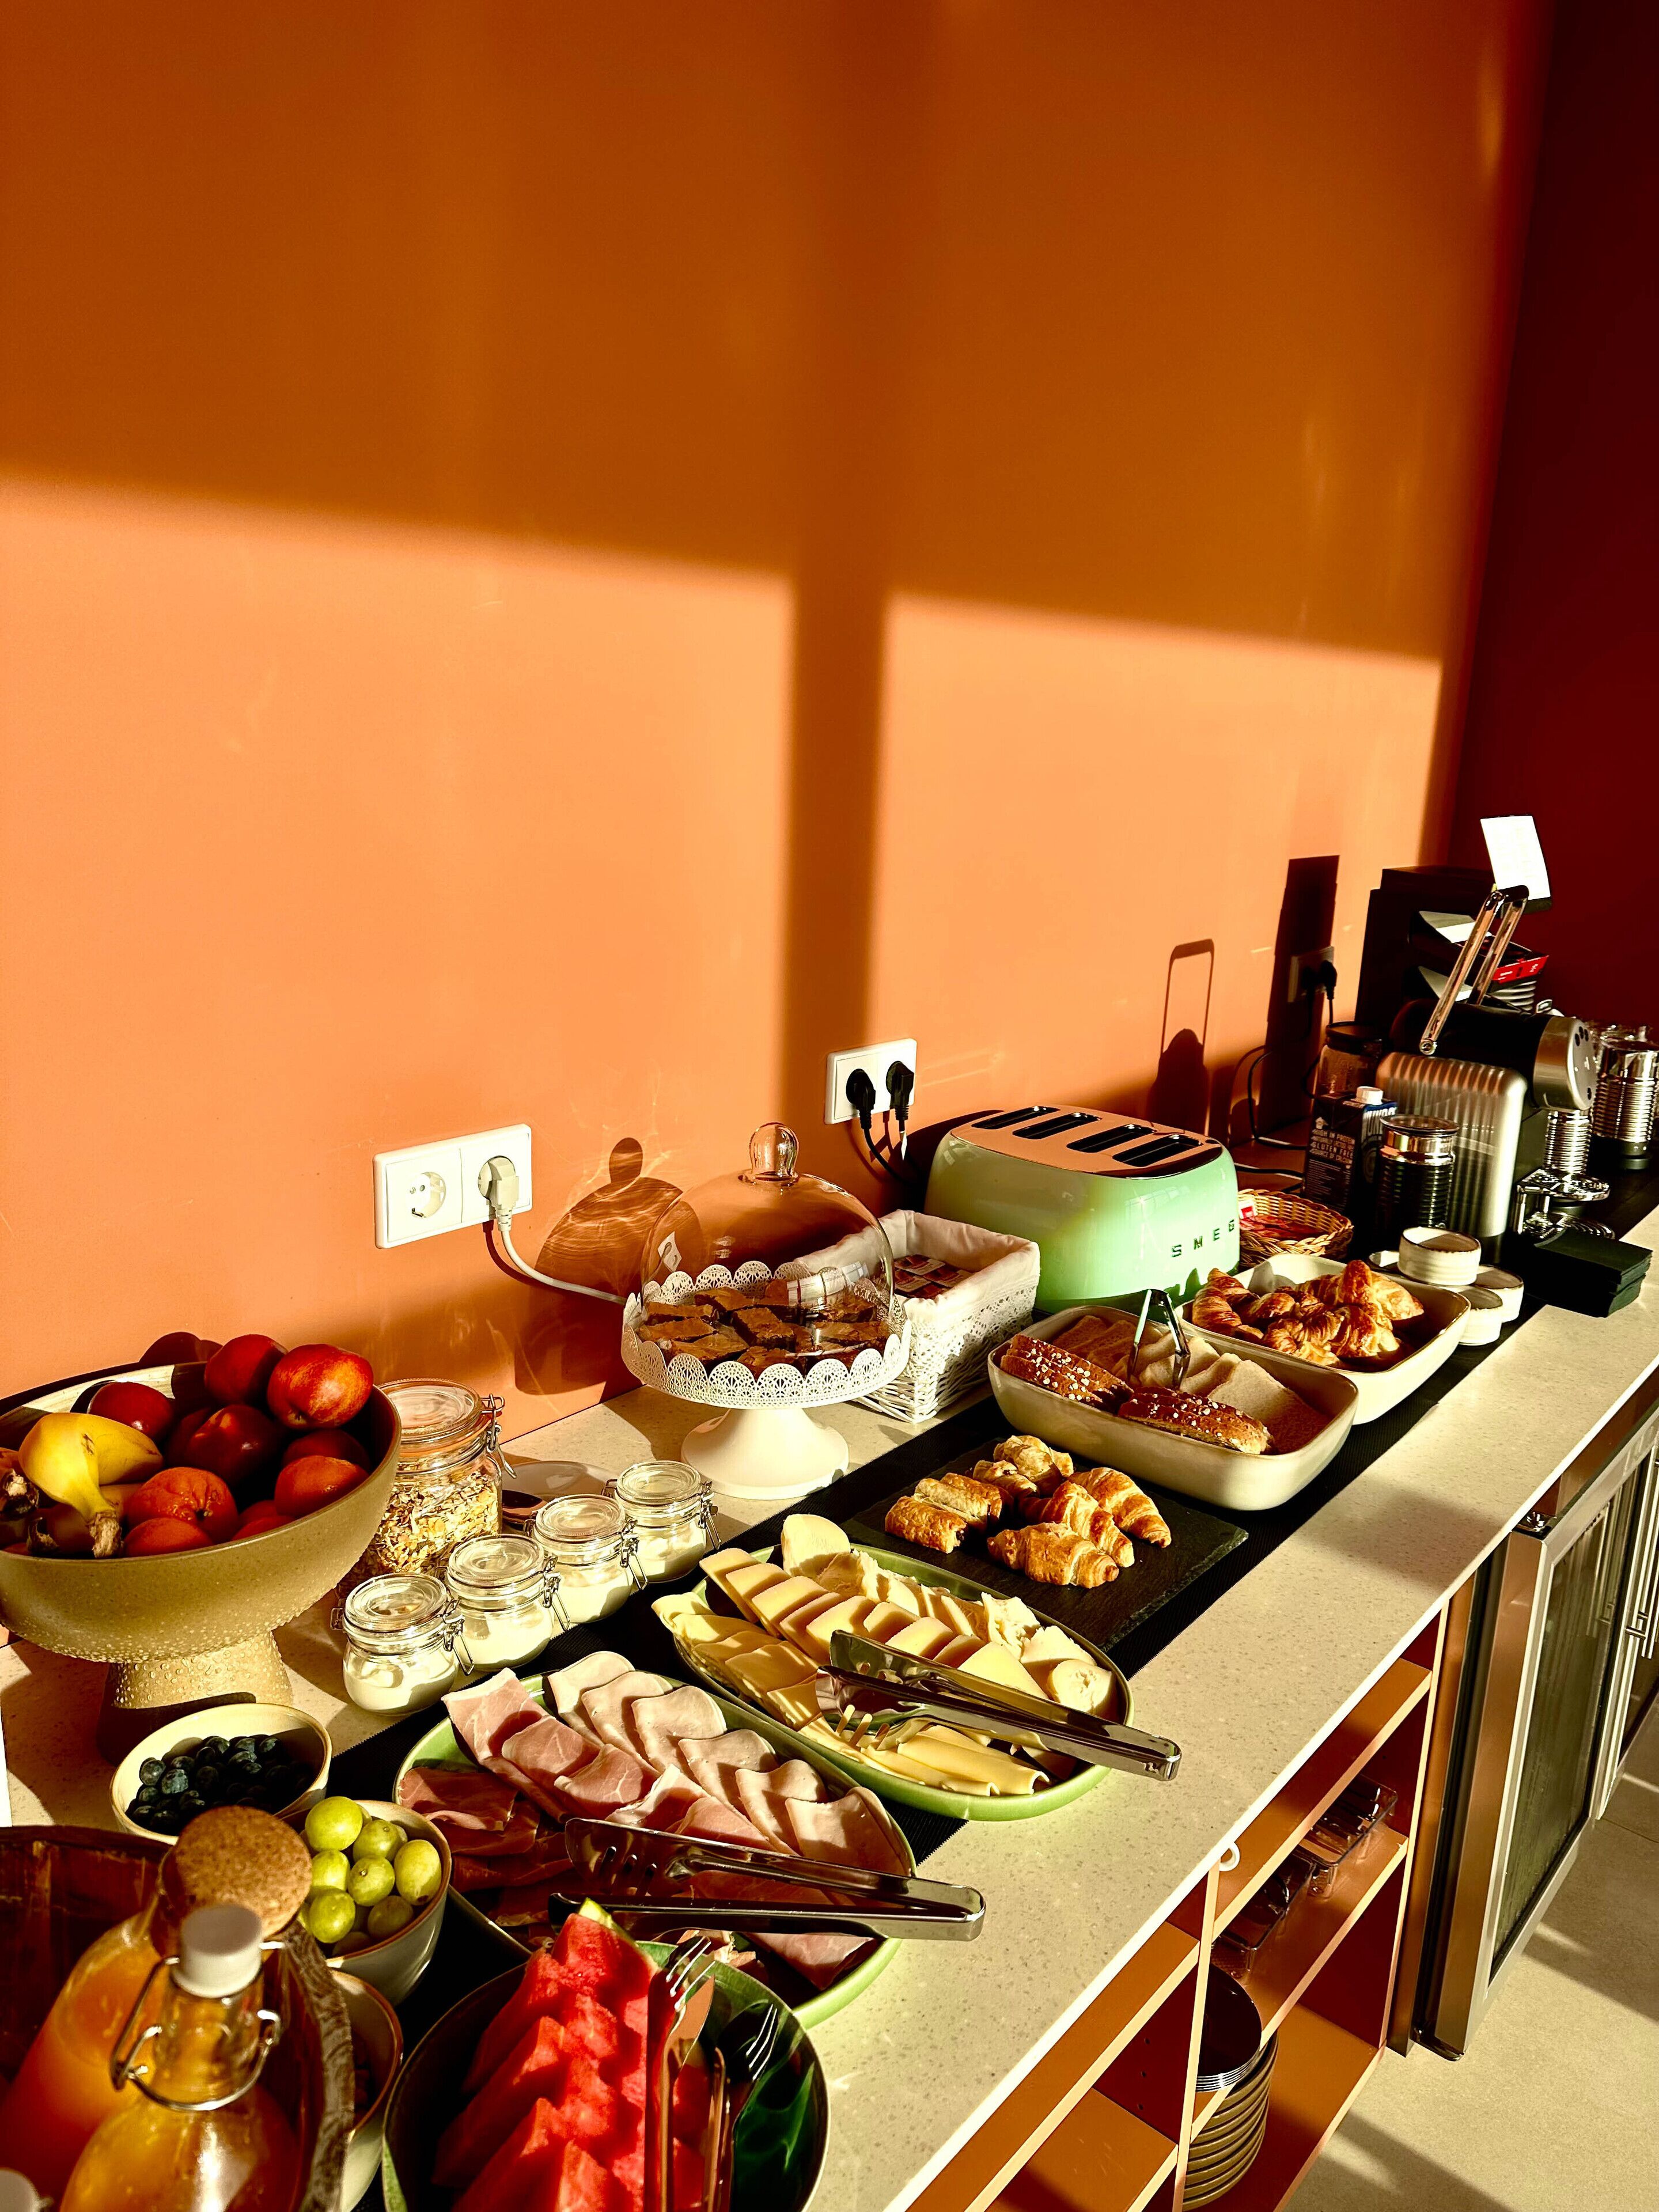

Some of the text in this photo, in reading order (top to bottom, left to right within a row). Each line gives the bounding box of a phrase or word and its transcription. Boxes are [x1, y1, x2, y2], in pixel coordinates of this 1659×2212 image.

[1312, 1142, 1337, 1153] GLUTEN
[1339, 1148, 1354, 1159] FREE
[1172, 1219, 1234, 1257] SMEG
